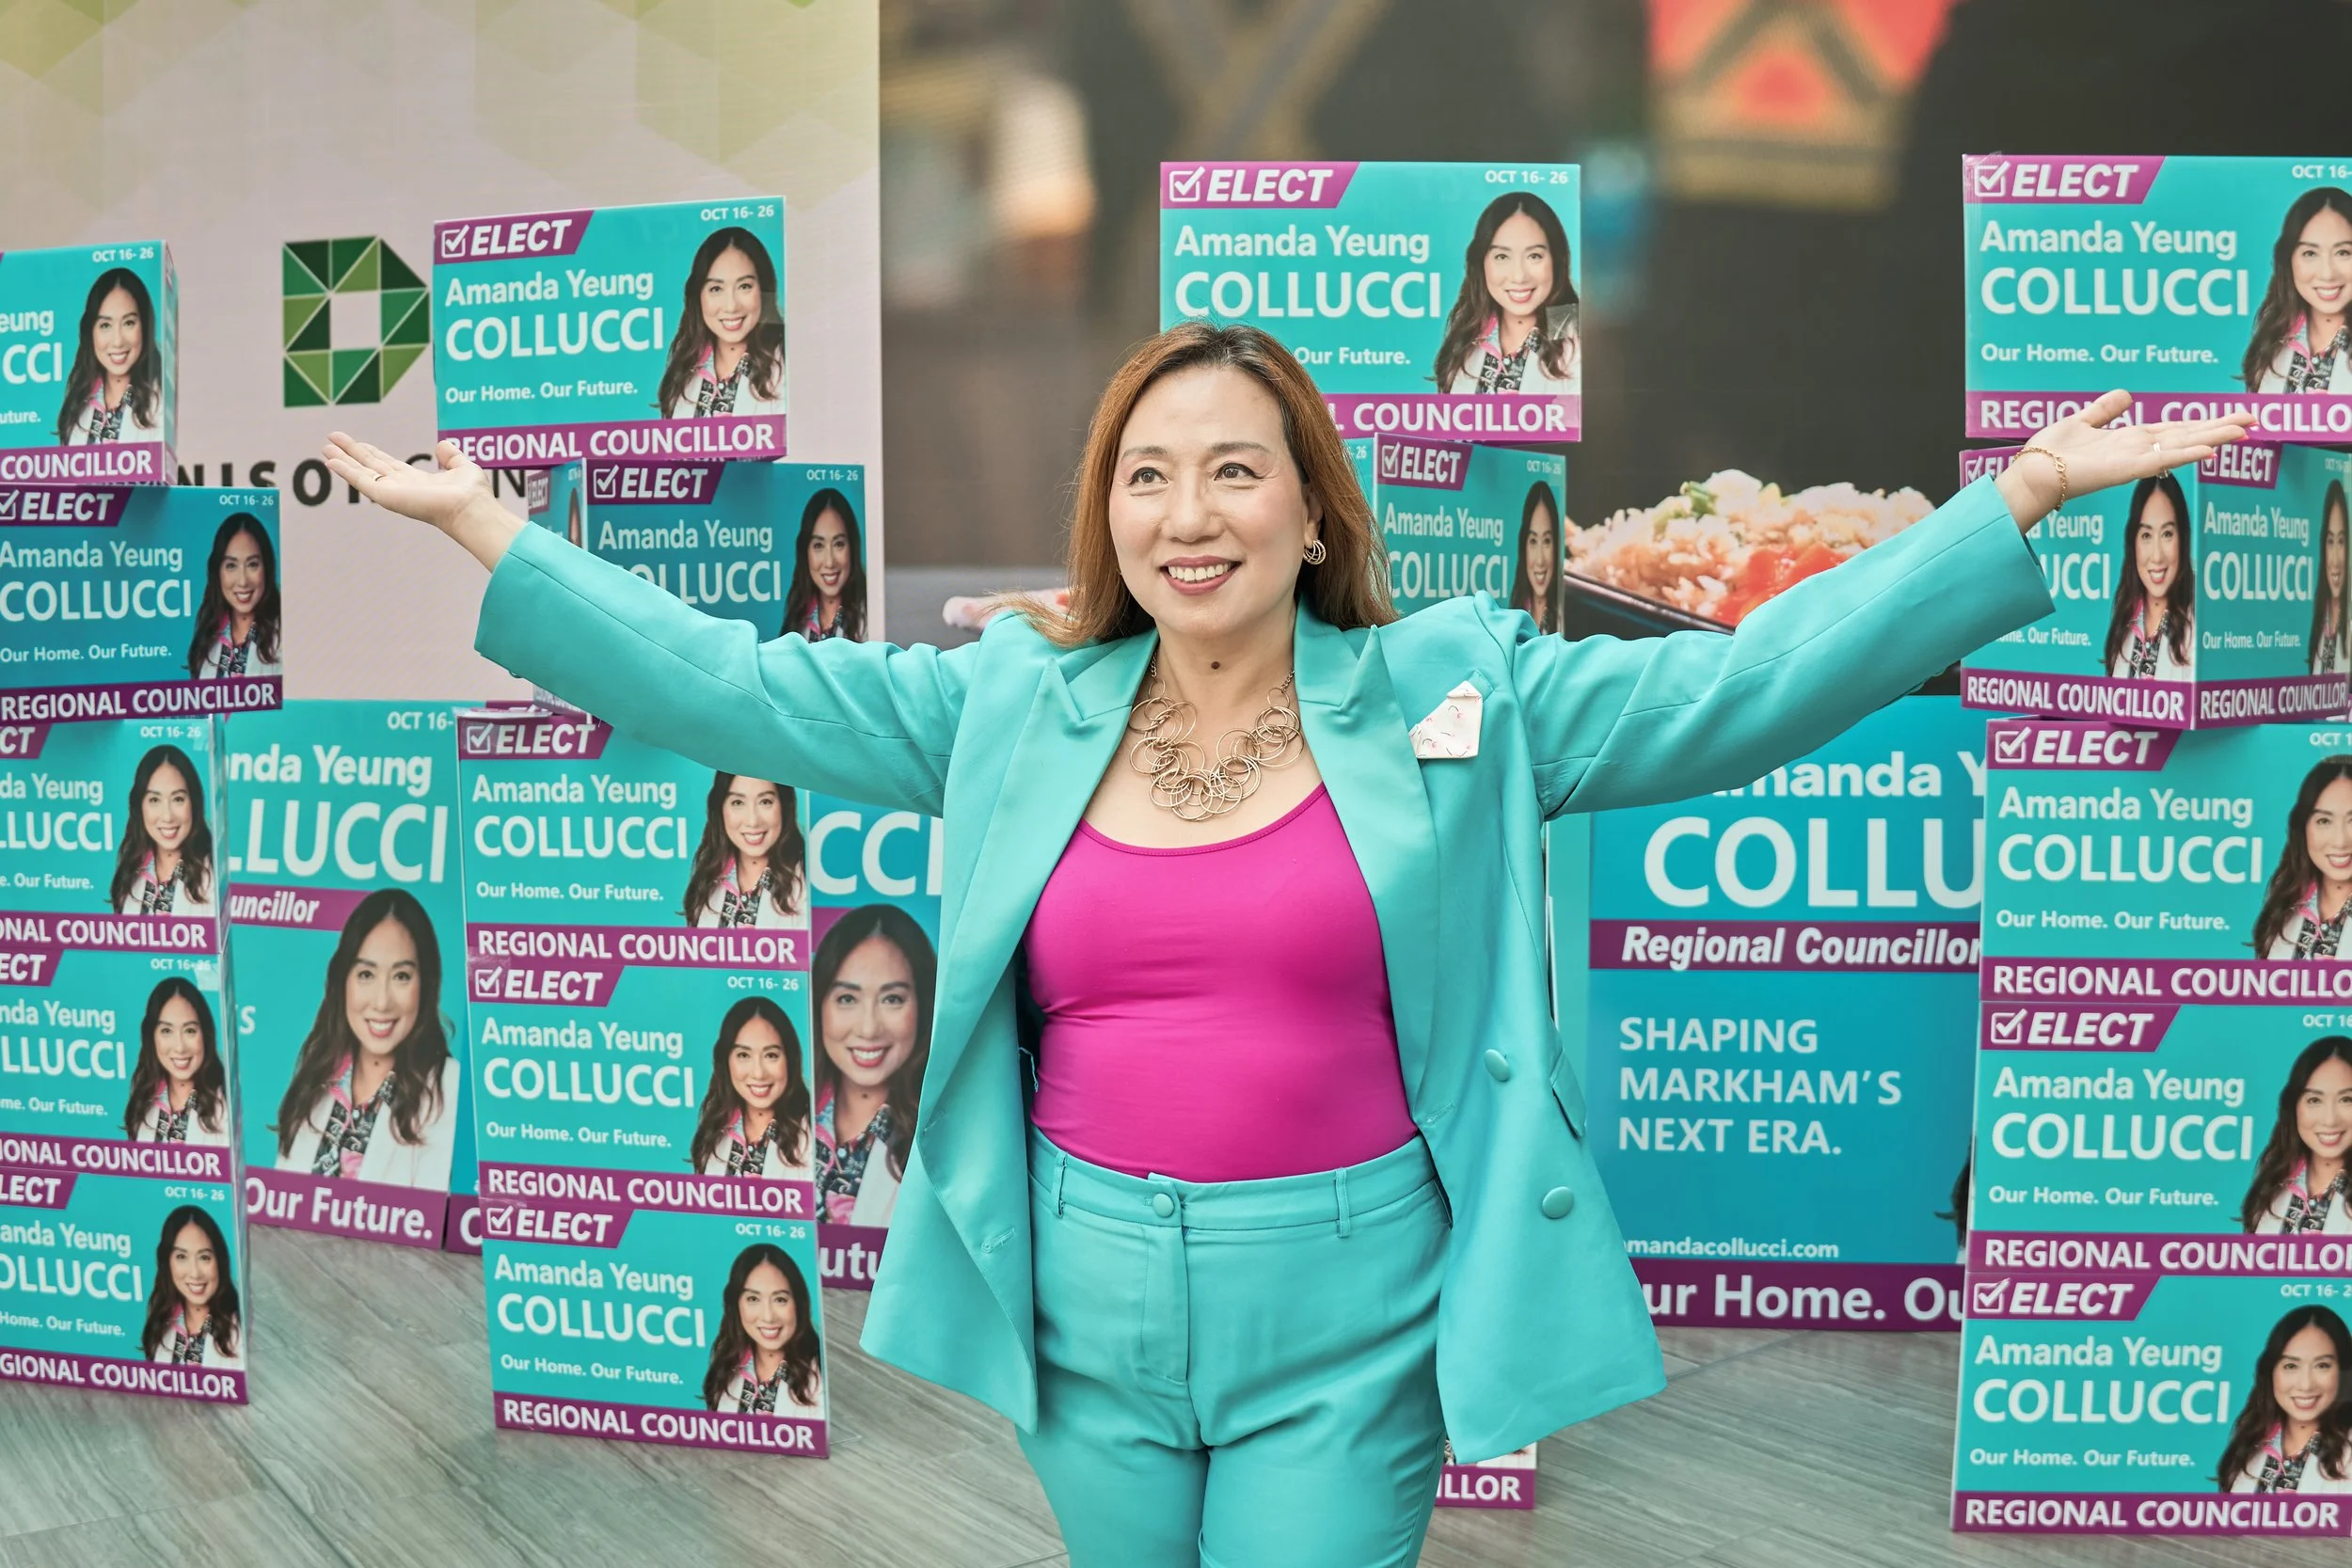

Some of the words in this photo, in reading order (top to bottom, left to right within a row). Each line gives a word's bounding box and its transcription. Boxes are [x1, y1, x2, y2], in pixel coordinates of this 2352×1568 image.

[1207, 168, 1333, 201] ELECT
[1485, 170, 1517, 183] OCT
[2011, 164, 2139, 198] ELECT
[2292, 165, 2324, 179] OCT
[701, 208, 728, 221] OCT
[470, 219, 572, 256] ELECT
[1174, 225, 1316, 256] Amanda
[1325, 225, 1429, 263] Yeung
[1979, 220, 2122, 253] Amanda
[2131, 221, 2236, 261] Yeung
[92, 249, 116, 262] OCT
[445, 271, 559, 307] Amanda
[566, 269, 653, 300] Yeung
[1175, 271, 1440, 319] COLLUCCI
[1981, 267, 2249, 316] COLLUCCI
[446, 308, 663, 361] COLLUCCI
[1293, 347, 1333, 366] Our
[1339, 347, 1410, 364] Future.
[1981, 343, 2021, 361] Our
[2026, 344, 2094, 361] Home.
[2101, 344, 2139, 362] Our
[2146, 345, 2218, 363] Future.
[445, 388, 476, 404] Our
[481, 386, 534, 401] Home.
[540, 382, 572, 398] Our
[578, 380, 638, 396] Future.
[1354, 401, 1568, 432] COUNCILLOR
[590, 424, 775, 456] COUNCILLOR
[1, 451, 152, 480] COUNCILLOR
[806, 469, 826, 481] OCT
[1401, 446, 1461, 483] ELECT
[2219, 444, 2273, 482] ELECT
[621, 468, 707, 499] ELECT
[21, 492, 114, 521] ELECT
[1382, 502, 1453, 539] Amanda
[1456, 508, 1503, 546] Yeung
[2204, 501, 2268, 537] Amanda
[2271, 507, 2310, 546] Yeung
[598, 519, 698, 549] Amanda
[705, 520, 772, 553] Yeung
[2045, 510, 2104, 545] Yeung
[0, 541, 103, 567] Amanda
[110, 541, 183, 572] Yeung
[1388, 551, 1507, 600] COLLUCCI
[2204, 551, 2312, 601] COLLUCCI
[0, 579, 191, 622] COLLUCCI
[0, 648, 29, 662] Our
[34, 647, 84, 660] Home.
[88, 644, 117, 659] Our
[121, 643, 171, 657] Future.
[2, 691, 129, 721] REGIONAL
[133, 684, 276, 713] COUNCILLOR
[1967, 676, 2053, 708] REGIONAL
[2058, 683, 2185, 721] COUNCILLOR
[2201, 688, 2275, 719] REGIONAL
[2279, 679, 2349, 714] COUNCILLOR
[388, 711, 421, 730] OCT
[494, 722, 596, 754] ELECT
[2032, 730, 2157, 764] ELECT
[313, 745, 432, 798] Yeung
[1712, 751, 1942, 797] manda
[472, 774, 584, 802] Amanda
[591, 775, 676, 810] Yeung
[1998, 786, 2140, 819] Amanda
[2150, 788, 2252, 828] Yeung
[475, 816, 687, 859] COLLUCCI
[1998, 834, 2263, 883] COLLUCCI
[476, 881, 506, 897] Our
[512, 882, 564, 898] Home.
[569, 883, 600, 899] Our
[605, 884, 663, 901] Future.
[56, 920, 207, 948] COUNCILLOR
[1996, 910, 2035, 927] Our
[2042, 911, 2107, 928] Home.
[2114, 911, 2153, 929] Our
[2159, 912, 2230, 929] Future.
[479, 930, 612, 958] REGIONAL
[619, 934, 797, 963] COUNCILLOR
[1622, 927, 1786, 971] Regional
[504, 970, 603, 1001] ELECT
[727, 976, 754, 989] OCT
[1994, 966, 2162, 995] REGIONAL
[482, 1017, 592, 1049] Amanda
[598, 1022, 683, 1059] Yeung
[1620, 1017, 1817, 1053] SHAPING
[2027, 1012, 2153, 1046] ELECT
[485, 1057, 693, 1107] COLLUCCI
[1993, 1067, 2134, 1100] Amanda
[2143, 1069, 2244, 1107] Yeung
[486, 1121, 516, 1137] Our
[521, 1124, 574, 1141] Home.
[578, 1127, 609, 1144] Our
[613, 1129, 671, 1148] Future.
[1620, 1117, 1733, 1151] NEXT
[1749, 1120, 1841, 1154] ERA.
[1993, 1113, 2252, 1161] COLLUCCI
[72, 1145, 221, 1177] COUNCILLOR
[489, 1169, 620, 1201] REGIONAL
[628, 1179, 803, 1213] COUNCILLOR
[244, 1178, 303, 1219] Our
[310, 1187, 432, 1241] Future.
[516, 1209, 612, 1243] ELECT
[736, 1223, 761, 1235] OCT
[1624, 1237, 1838, 1258] mandacollucci.com
[1986, 1240, 2151, 1268] REGIONAL
[2160, 1242, 2352, 1271] COUNCILLO
[495, 1254, 603, 1288] Amanda
[610, 1263, 693, 1301] Yeung
[1715, 1275, 1885, 1320] Home.
[2010, 1283, 2134, 1315] ELECT
[498, 1291, 705, 1347] COLLUCCI
[501, 1354, 531, 1370] Our
[534, 1357, 586, 1375] Home.
[591, 1363, 621, 1379] Our
[626, 1366, 683, 1385] Future.
[1975, 1335, 2113, 1366] Amanda
[2122, 1337, 2222, 1373] Yeung
[90, 1360, 240, 1401] COUNCILLOR
[1974, 1379, 2230, 1423] COLLUCCI
[504, 1400, 634, 1434] REGIONAL
[641, 1410, 817, 1450] COUNCILLOR
[1970, 1449, 2008, 1465] Our
[2013, 1449, 2077, 1465] Home.
[2084, 1449, 2122, 1465] Our
[2127, 1449, 2195, 1466] Future.
[1966, 1499, 2127, 1526] REGIONAL
[2137, 1501, 2339, 1528] COUNCILLOR
